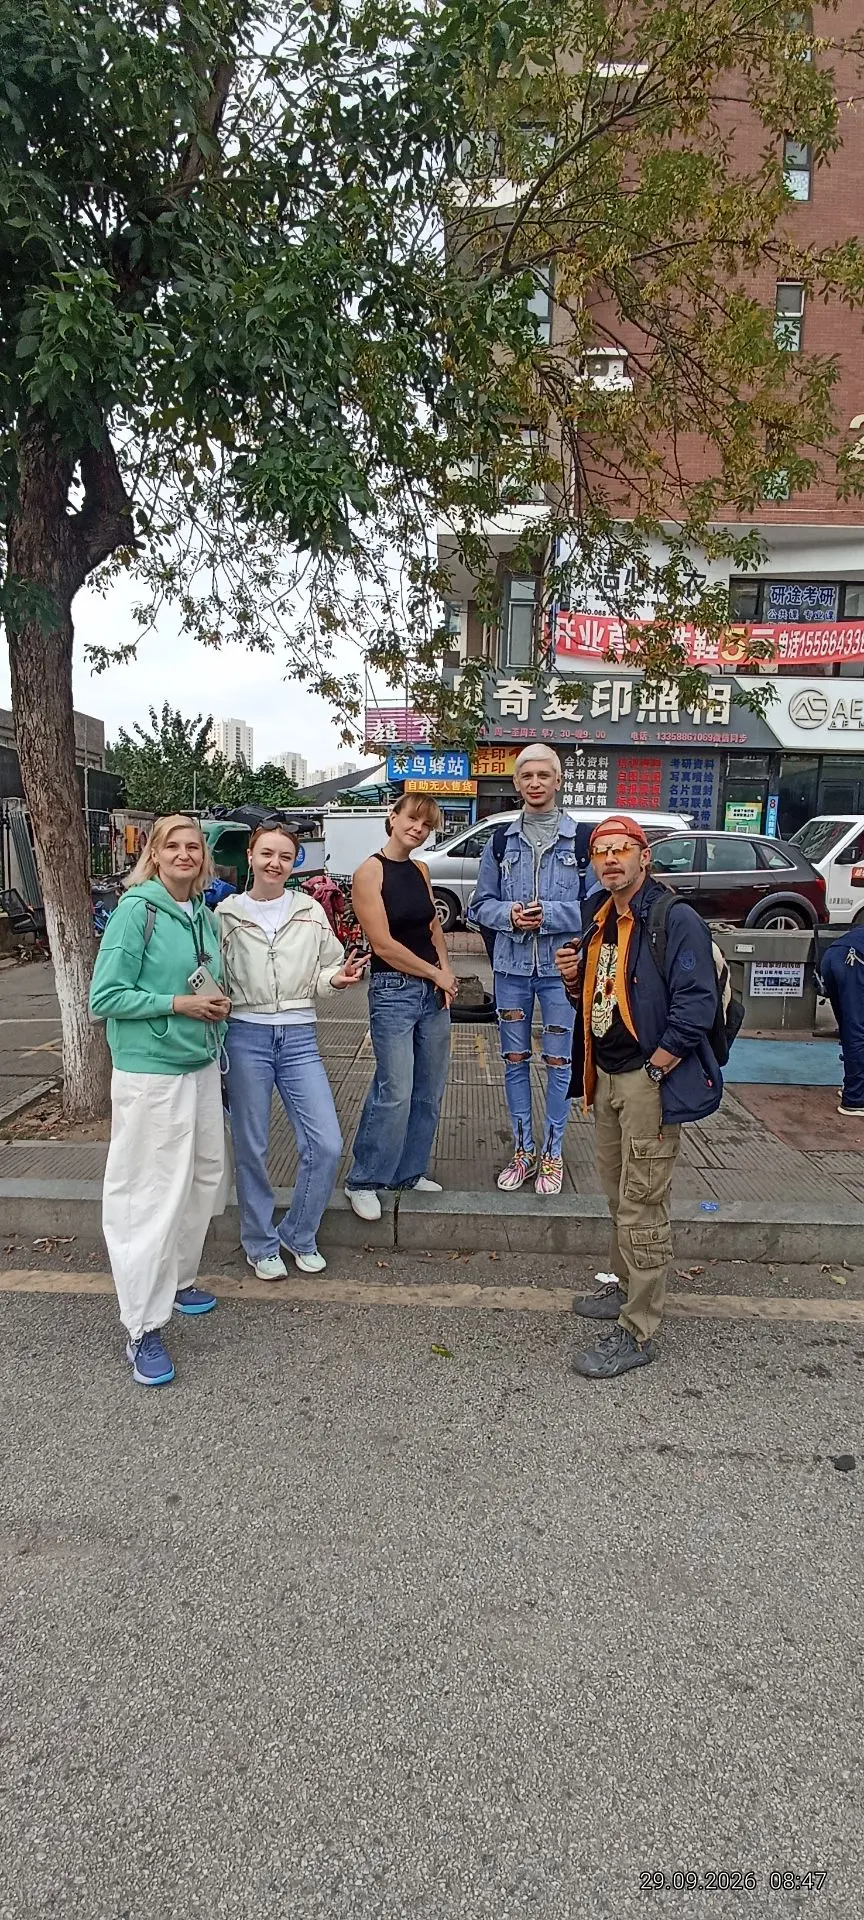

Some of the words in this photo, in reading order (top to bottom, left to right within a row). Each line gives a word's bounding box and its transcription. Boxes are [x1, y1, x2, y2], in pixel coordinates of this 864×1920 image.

[770, 585, 836, 606] 研途考研
[767, 608, 800, 621] 公共课
[803, 609, 836, 621] 专业课
[393, 755, 465, 776] 菜鸟驿站
[473, 761, 506, 774] 打印
[564, 755, 609, 768] 会议资料
[670, 758, 715, 770] 考研资料
[563, 768, 608, 781] 标书胶装
[408, 780, 473, 792] 自助无人售货
[563, 781, 608, 794] 传单画册
[562, 794, 607, 806] 牌匾灯箱
